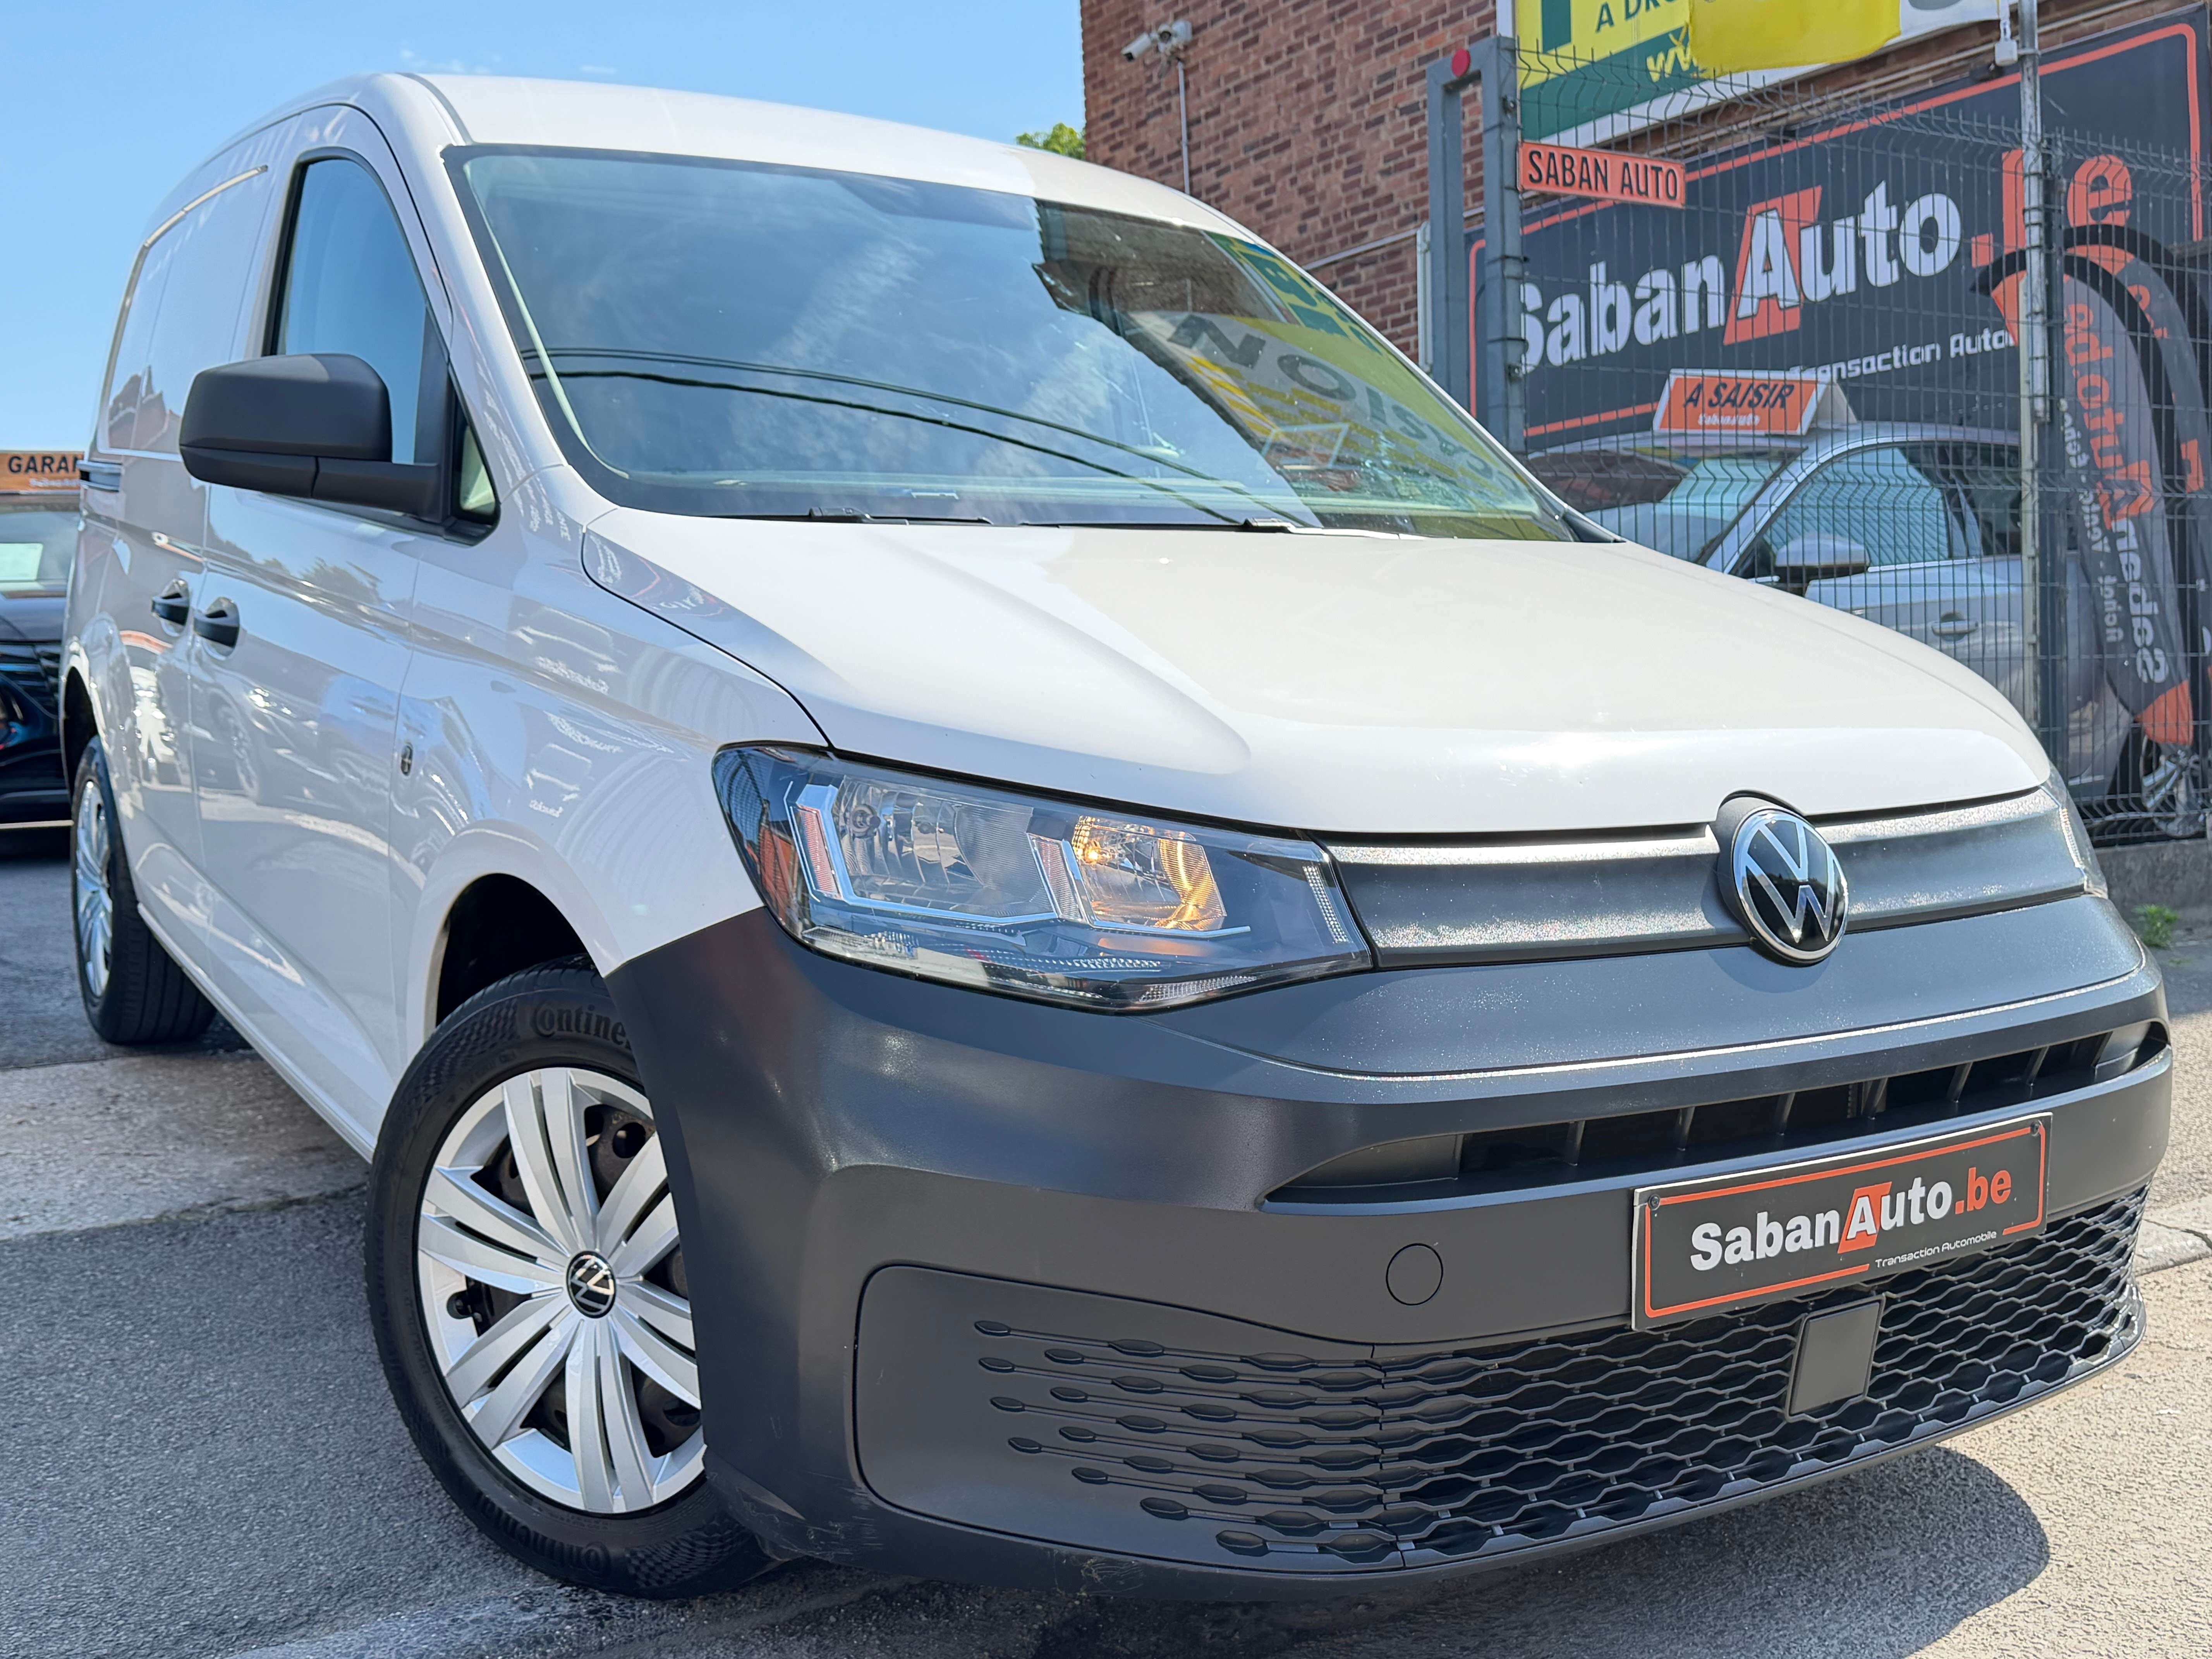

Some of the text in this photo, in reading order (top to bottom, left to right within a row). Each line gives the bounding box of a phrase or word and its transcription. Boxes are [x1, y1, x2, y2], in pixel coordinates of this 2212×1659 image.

[1528, 149, 1678, 201] SABAN AUTO
[1708, 382, 1794, 409] SAISIR
[531, 1003, 631, 1050] Contine
[1690, 1167, 2011, 1271] SabanAuto.be
[1875, 1231, 1997, 1268] Transaction Automobile
